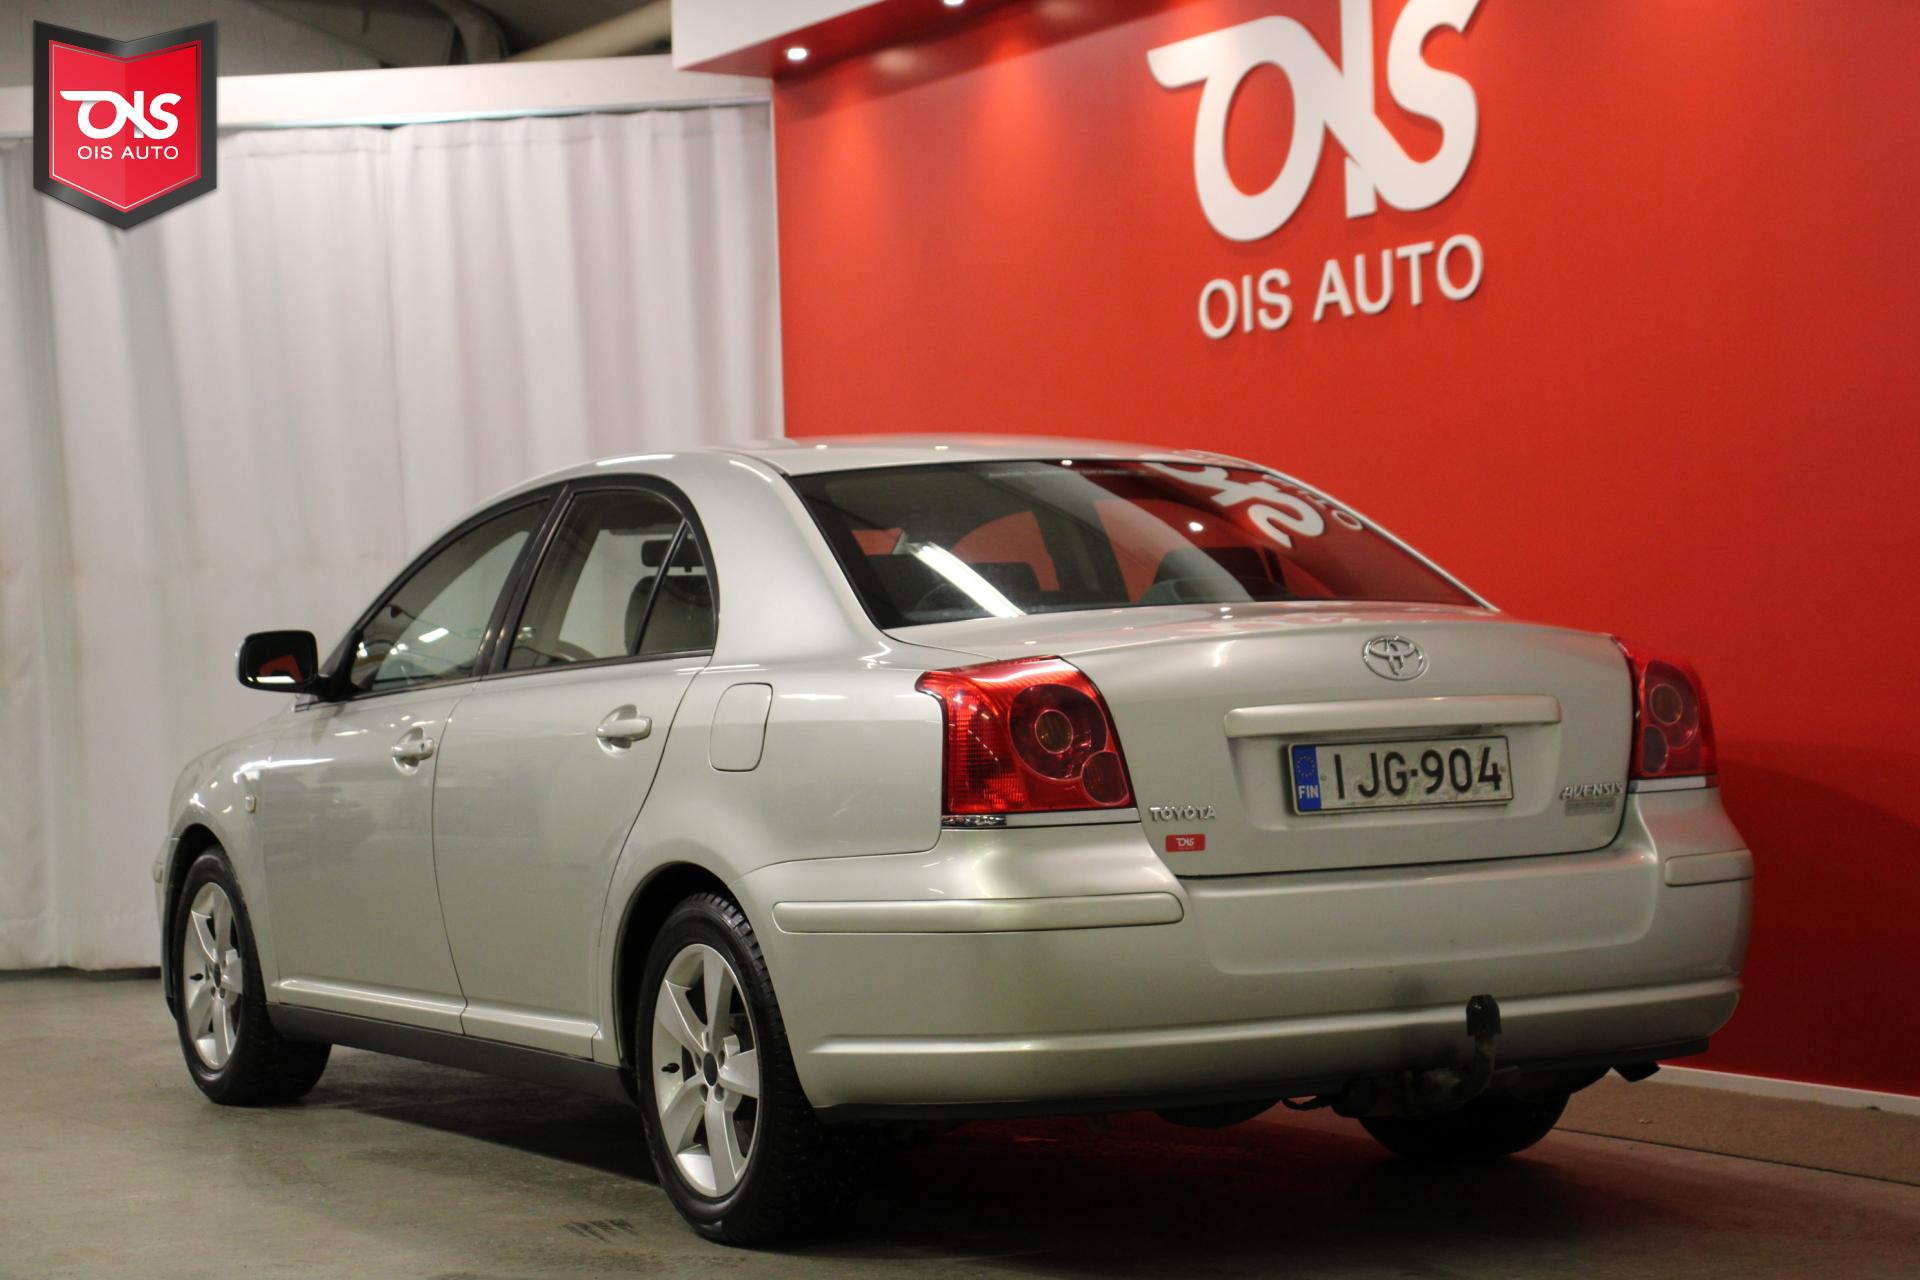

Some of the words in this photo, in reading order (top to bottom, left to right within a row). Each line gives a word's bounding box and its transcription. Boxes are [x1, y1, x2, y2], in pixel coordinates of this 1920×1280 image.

[1198, 268, 1292, 339] OIS
[1313, 234, 1484, 322] AUTO
[1333, 746, 1502, 800] IJG-904
[1298, 784, 1320, 799] FIN
[1560, 783, 1622, 800] AVENSIS
[1149, 805, 1216, 821] TOYOTA
